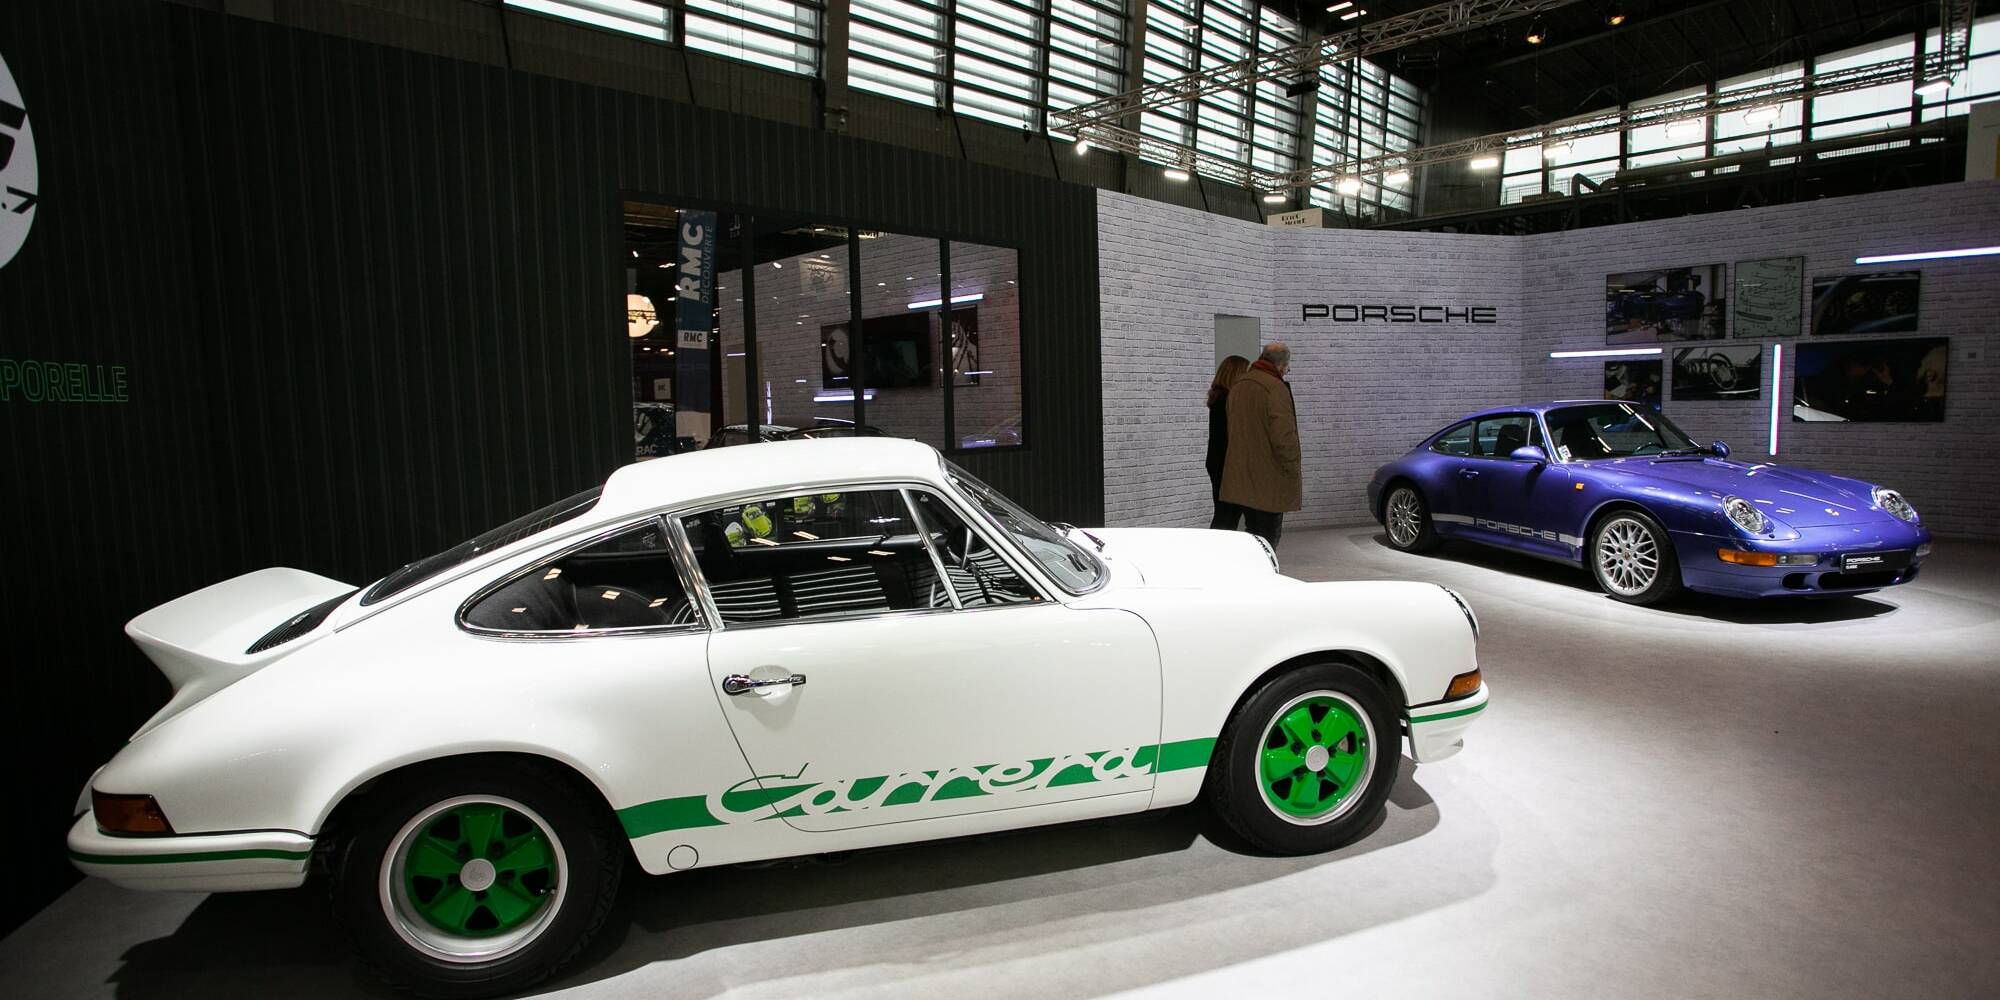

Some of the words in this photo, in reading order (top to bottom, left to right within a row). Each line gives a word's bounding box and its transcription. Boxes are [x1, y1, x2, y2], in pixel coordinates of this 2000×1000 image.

[679, 221, 704, 301] RMC
[1303, 304, 1496, 323] PORSCHE
[684, 331, 702, 343] RMC
[1476, 518, 1557, 541] PORSCHE
[706, 745, 1155, 823] Carrera
